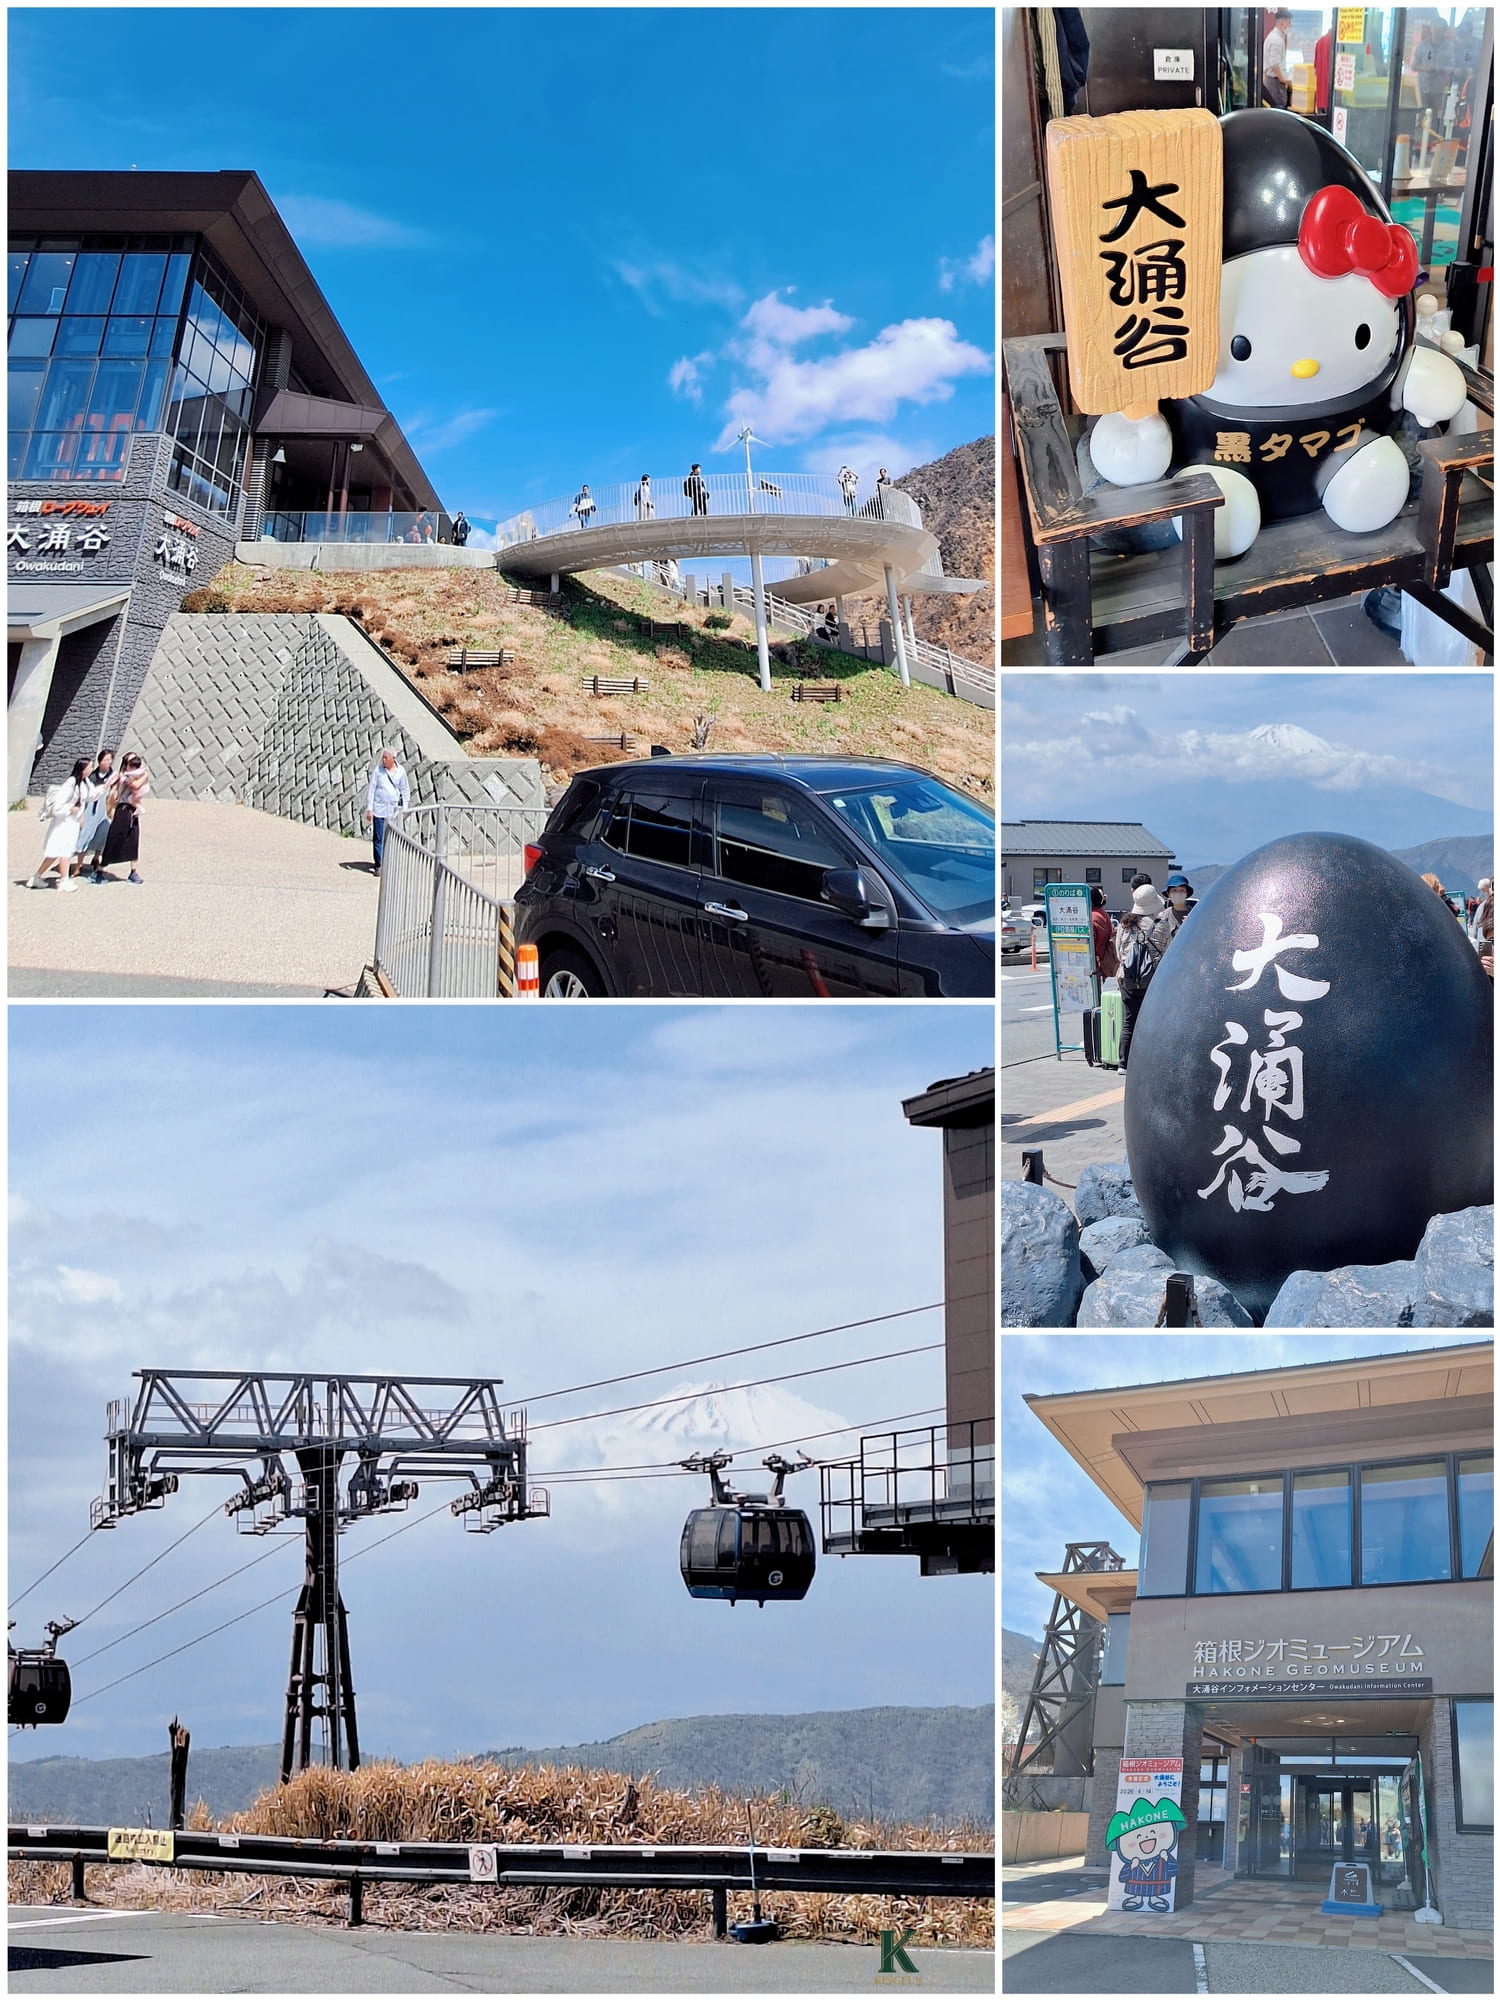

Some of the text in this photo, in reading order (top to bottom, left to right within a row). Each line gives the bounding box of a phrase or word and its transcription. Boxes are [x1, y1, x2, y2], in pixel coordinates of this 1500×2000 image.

[1157, 66, 1190, 74] PRIVATE
[1098, 168, 1189, 371] 大涌谷
[1213, 417, 1366, 463] 黒タマゴ
[15, 500, 111, 515] 箱根ロープウェイ
[7, 523, 112, 551] 大涌谷
[154, 532, 199, 570] 大涌谷
[15, 560, 85, 572] Owakudani
[1197, 912, 1331, 1213] 大涌谷
[1194, 1633, 1425, 1665] 箱根ジオミュージアム
[1193, 1662, 1425, 1678] HAKONE GEOMUSEUM
[1192, 1682, 1325, 1695] 大涌谷インフォメーションセンター
[1364, 1682, 1402, 1690] Information
[1403, 1681, 1425, 1689] Center
[1120, 1809, 1169, 1831] HAKONE
